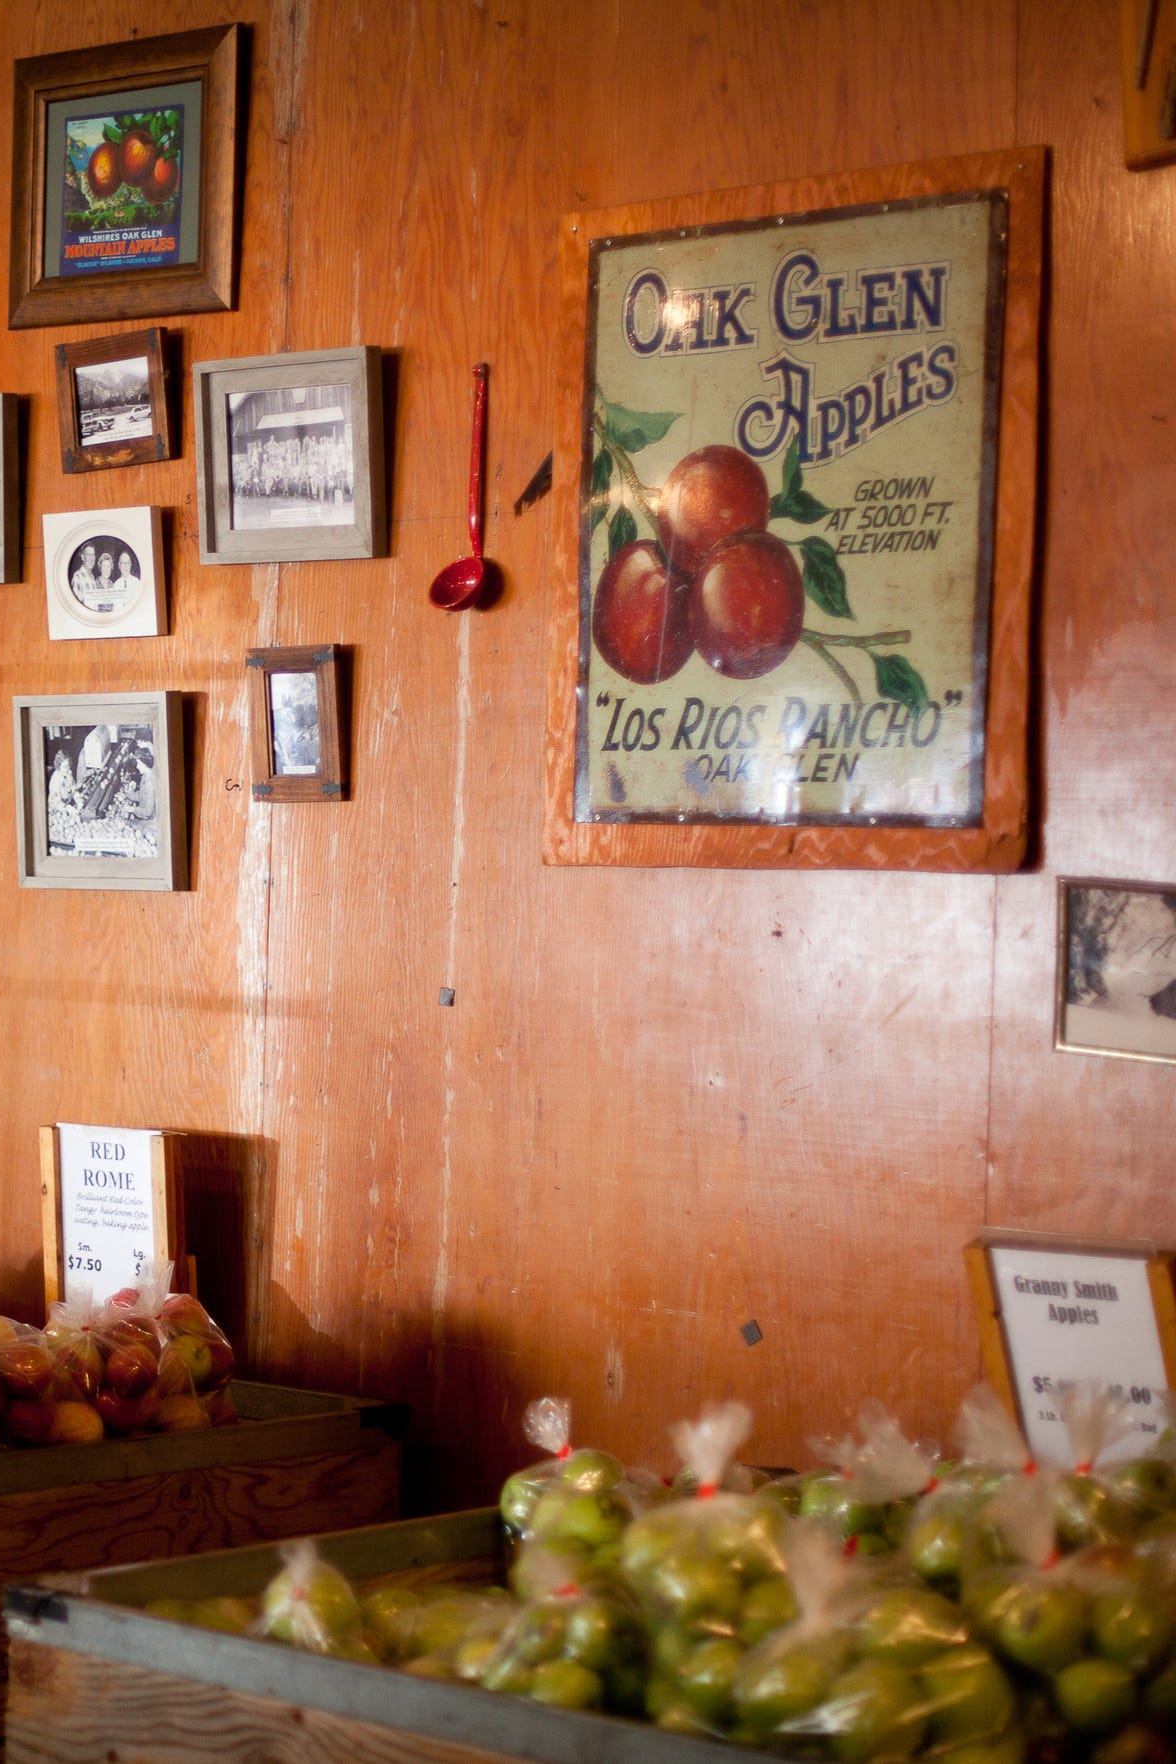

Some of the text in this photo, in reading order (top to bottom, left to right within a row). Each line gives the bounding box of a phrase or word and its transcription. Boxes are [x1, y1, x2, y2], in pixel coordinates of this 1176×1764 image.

[64, 237, 176, 258] MOUNTAIN APPLES
[78, 232, 120, 244] WILSHIRES
[122, 231, 140, 240] OAK
[141, 229, 163, 239] GLEN
[623, 249, 951, 357] OAK GLEN
[734, 340, 959, 468] APPLES
[854, 476, 935, 501] GROWN
[824, 501, 956, 532] AT 5000 FT.
[836, 528, 944, 555] ELEVATION
[671, 697, 767, 752] RIOS
[694, 753, 860, 783] OAK LEN
[90, 1141, 126, 1161] RED
[83, 1168, 136, 1191] ROME
[68, 1255, 102, 1272] $7.50
[78, 1242, 146, 1261] Sm. Lg.
[1013, 1275, 1119, 1302] Granny Smith
[1048, 1303, 1100, 1325] Apples
